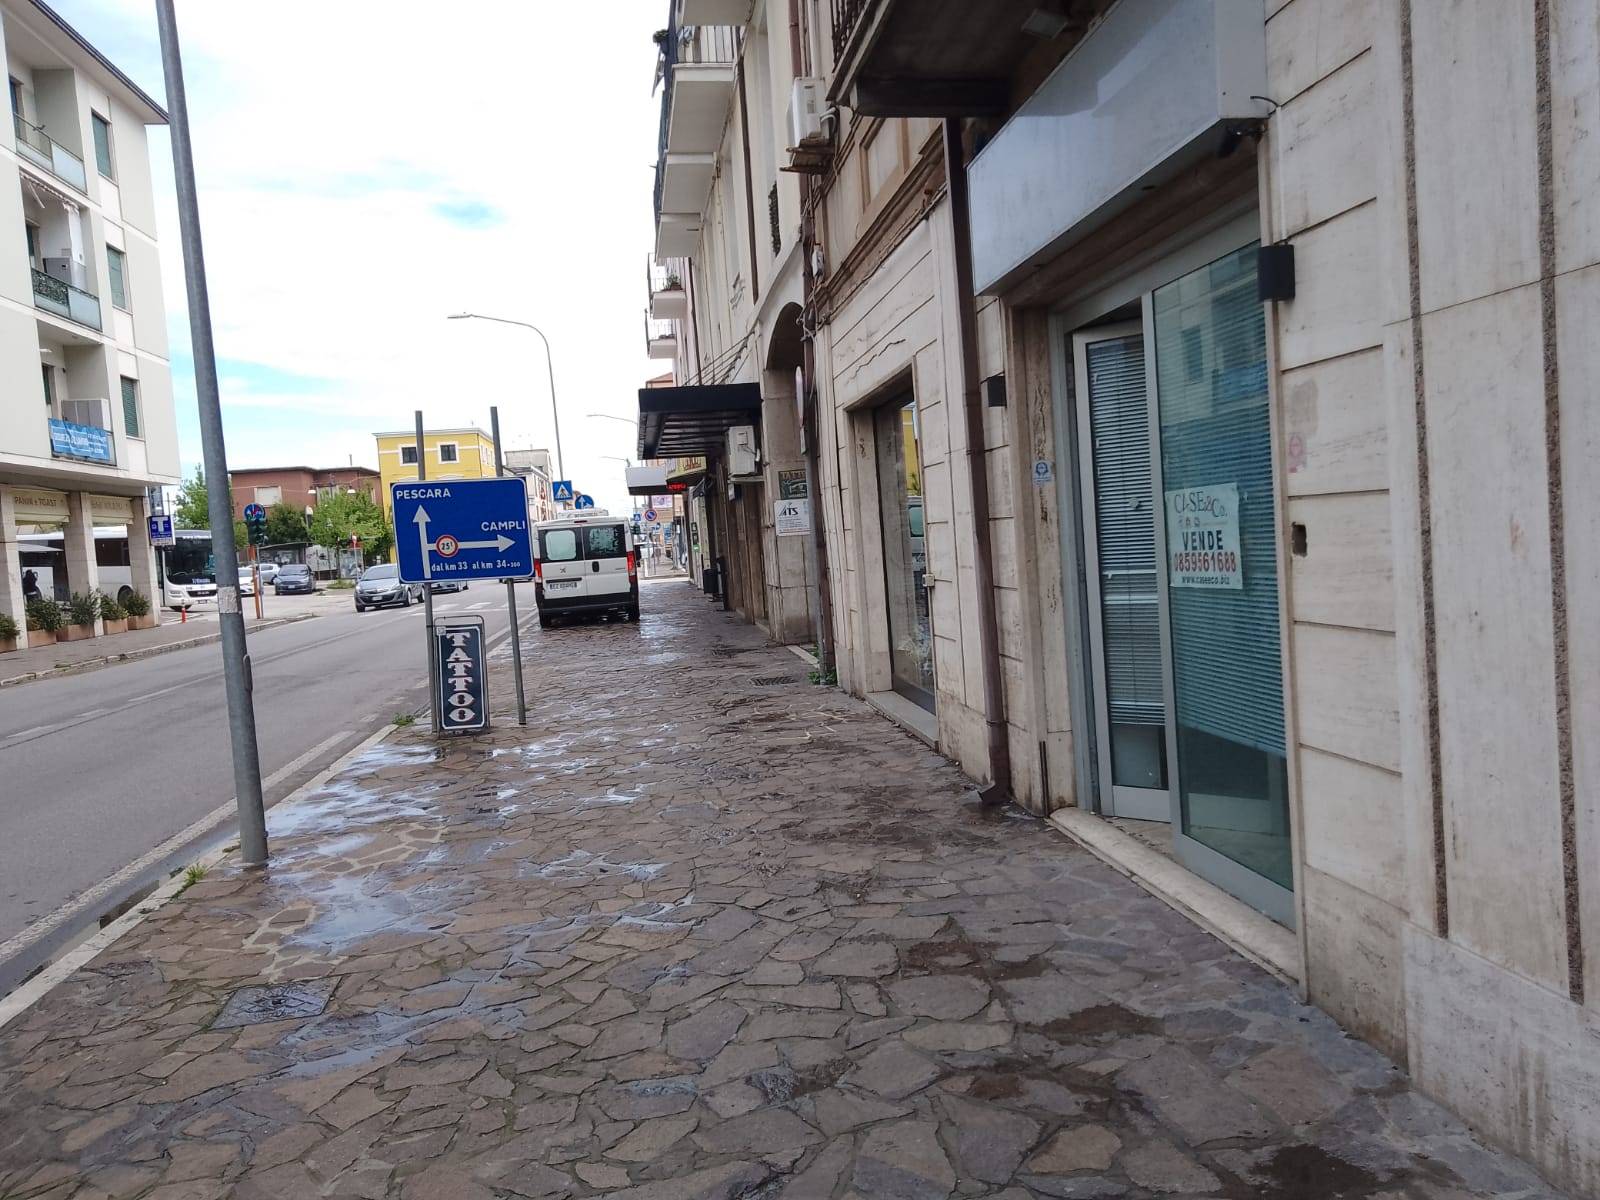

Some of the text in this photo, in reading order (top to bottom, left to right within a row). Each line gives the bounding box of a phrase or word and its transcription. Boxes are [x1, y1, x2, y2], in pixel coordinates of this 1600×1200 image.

[396, 488, 451, 500] PESCARA
[39, 498, 57, 507] TOAST
[481, 520, 526, 531] CAMPLI
[1182, 529, 1224, 551] VENDE
[431, 562, 444, 572] dal
[445, 562, 457, 571] km
[457, 561, 468, 570] 33
[472, 560, 480, 570] al
[481, 560, 493, 569] km
[446, 632, 475, 722] TATTOO
